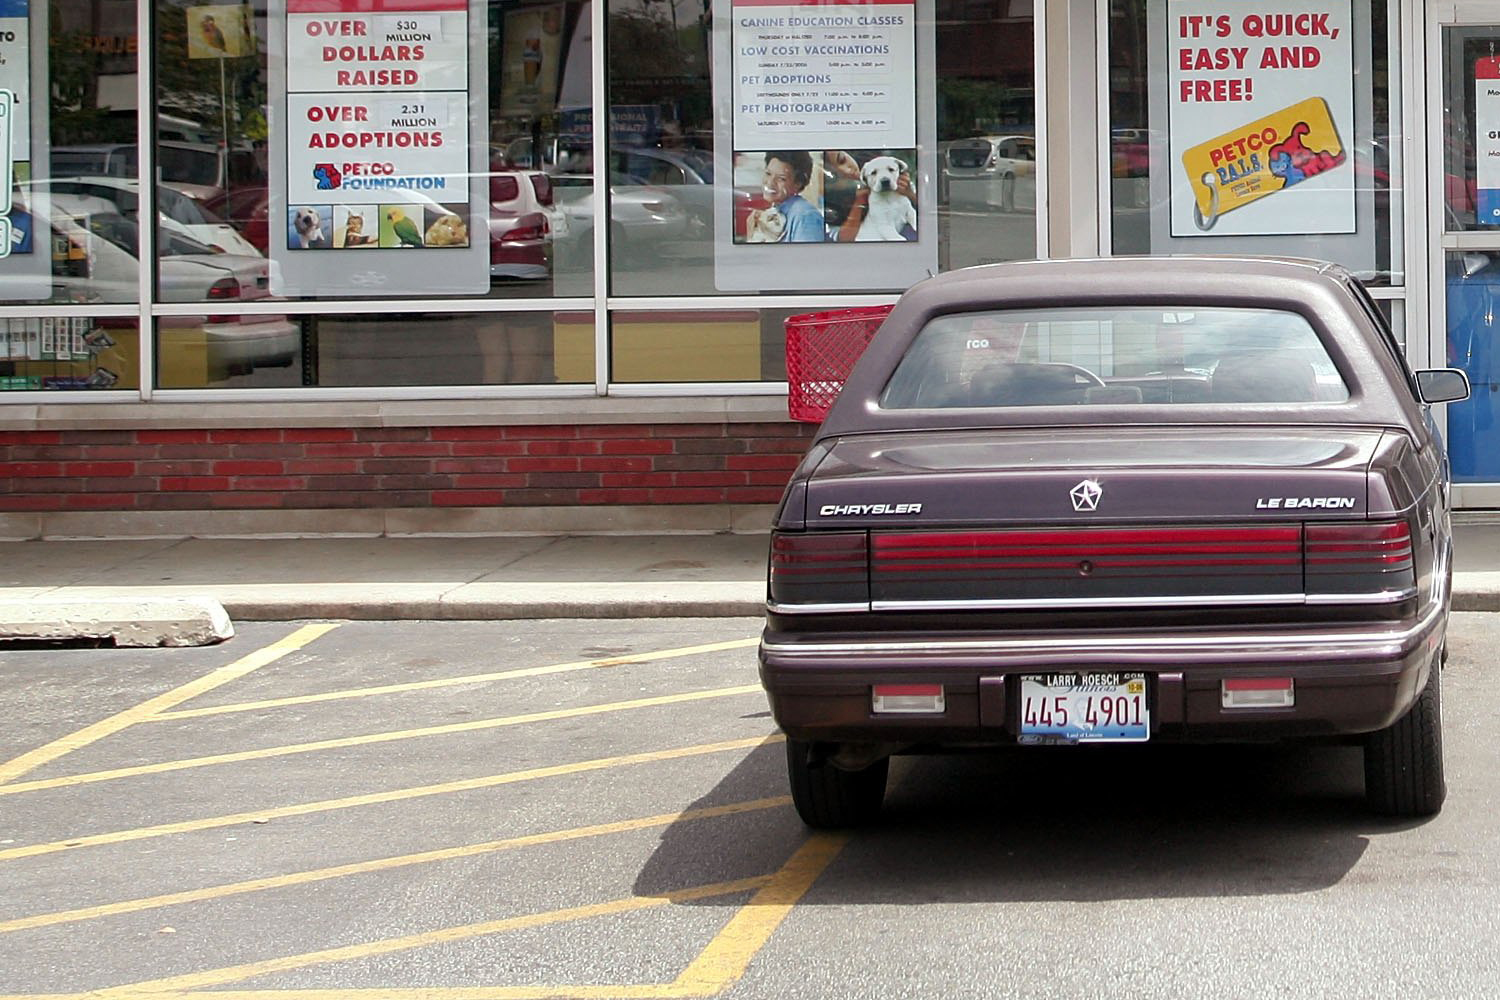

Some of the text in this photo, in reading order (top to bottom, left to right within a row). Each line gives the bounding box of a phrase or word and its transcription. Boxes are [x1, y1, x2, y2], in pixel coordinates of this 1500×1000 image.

[306, 20, 367, 36] OVER
[396, 20, 418, 31] $30
[740, 16, 904, 28] CANINE EDUCATION CLASSES
[1179, 13, 1340, 40] IT'S QUICK,
[386, 33, 431, 42] MILLION
[322, 45, 424, 62] DOLLARS
[741, 45, 889, 56] LOW COST VACCINATIONS
[1179, 46, 1321, 71] EASY AND
[336, 69, 418, 86] RAISED
[741, 74, 832, 85] PET ADOPTIONS
[1180, 78, 1254, 103] FREE!
[307, 106, 368, 122] OVER
[401, 105, 425, 114] 2.31
[741, 103, 852, 113] PET PHOTOGRAPHY
[391, 118, 437, 127] MILLION
[308, 131, 443, 148] ADOPTIONS
[1209, 127, 1277, 167] PETCO
[342, 162, 395, 176] PETCO
[342, 177, 446, 190] FOUNDATION
[820, 503, 922, 516] CHRYSLER
[1256, 497, 1356, 509] LE BARON
[1047, 674, 1077, 687] LARRY
[1024, 695, 1144, 727] 445 4901
